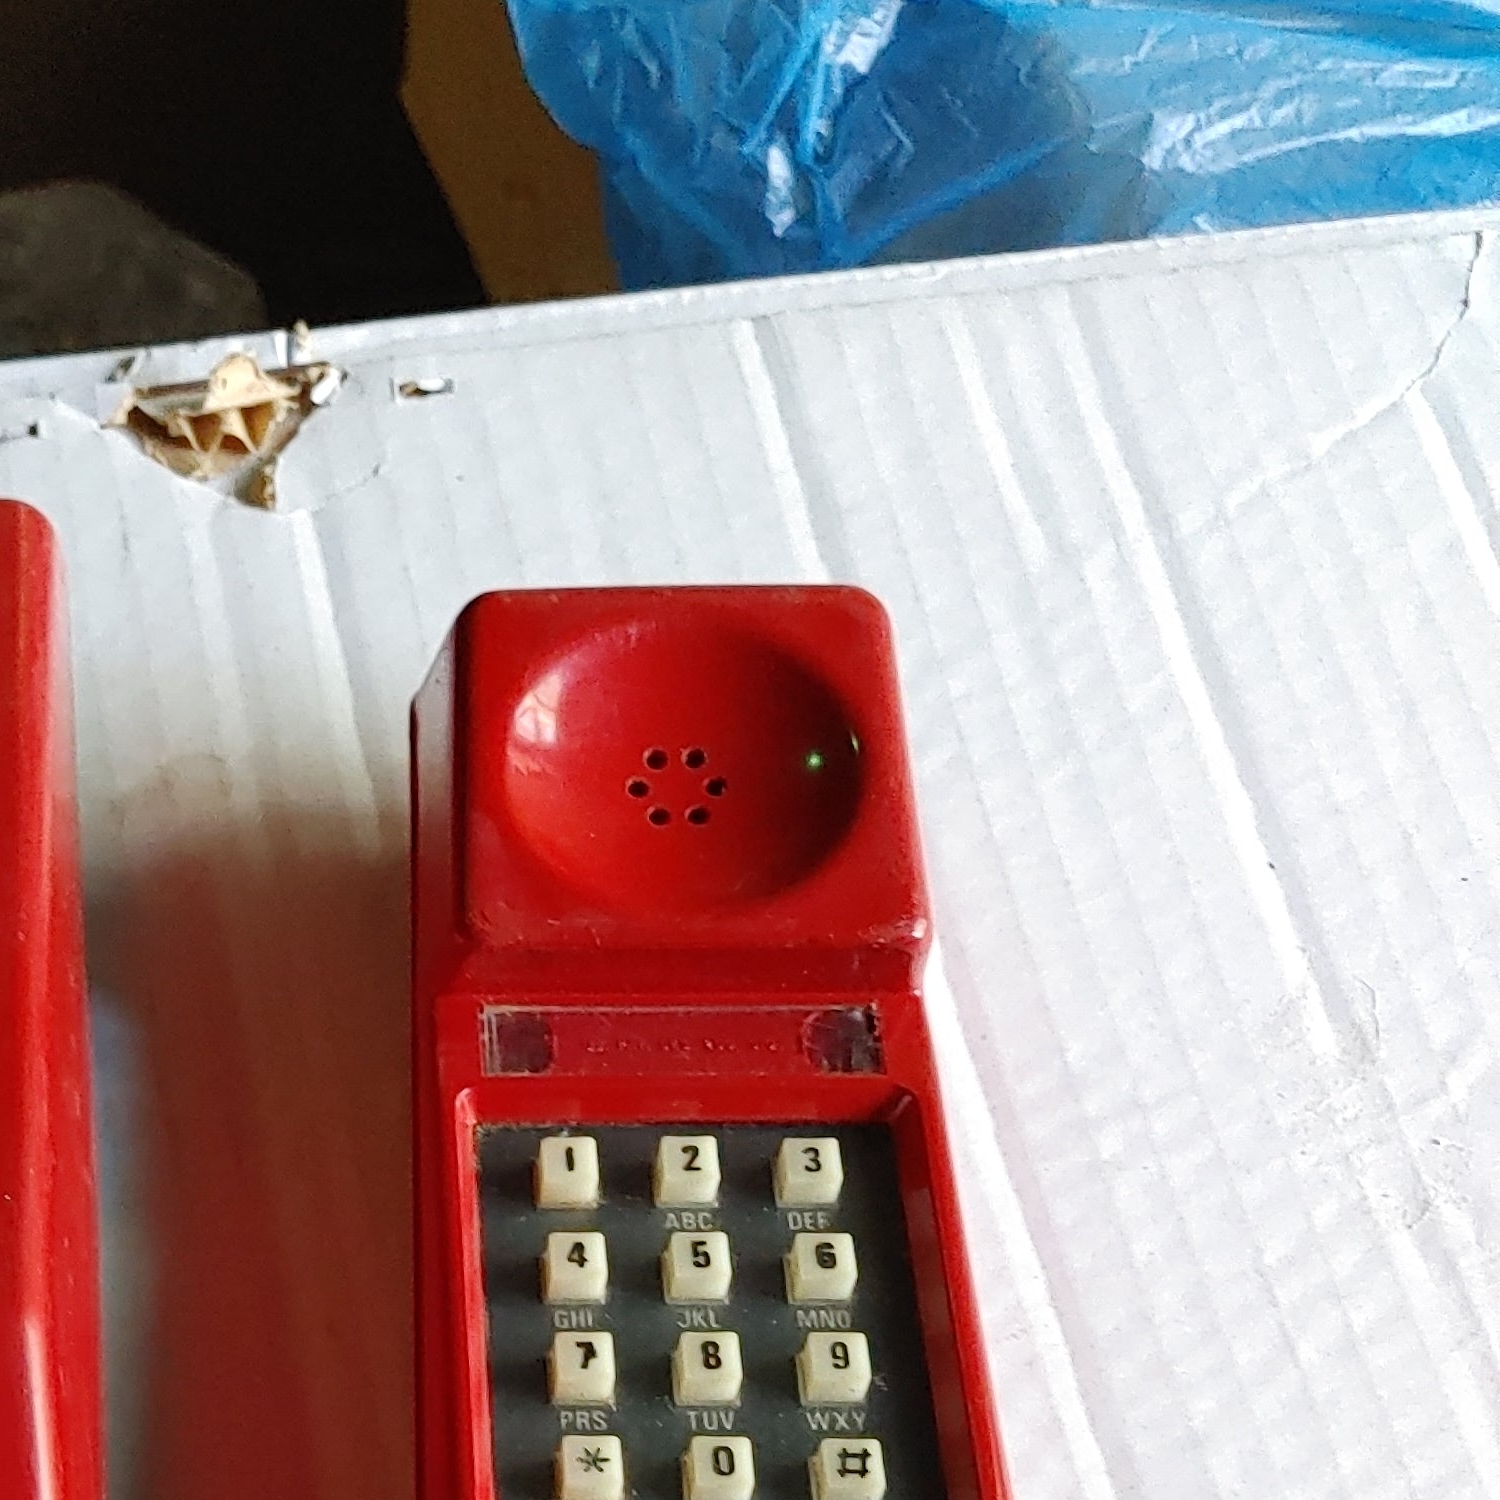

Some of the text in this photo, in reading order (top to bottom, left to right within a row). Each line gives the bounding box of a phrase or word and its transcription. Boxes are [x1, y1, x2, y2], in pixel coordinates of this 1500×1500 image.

[564, 1146, 577, 1172] 1
[680, 1145, 703, 1172] 2
[803, 1146, 823, 1174] 3
[664, 1211, 714, 1231] ABC
[787, 1211, 831, 1231] DEF
[566, 1241, 589, 1269] 4
[691, 1240, 712, 1269] 5
[814, 1242, 838, 1270] 6
[553, 1309, 595, 1330] GHI
[676, 1310, 721, 1330] JKL
[797, 1309, 853, 1330] MNO
[575, 1340, 599, 1370] 7
[700, 1340, 723, 1370] 8
[830, 1340, 851, 1370] 9
[560, 1410, 608, 1431] PRS
[687, 1410, 736, 1431] TUV
[805, 1410, 868, 1432] WXY
[711, 1445, 736, 1477] 0
[836, 1447, 872, 1479] #
